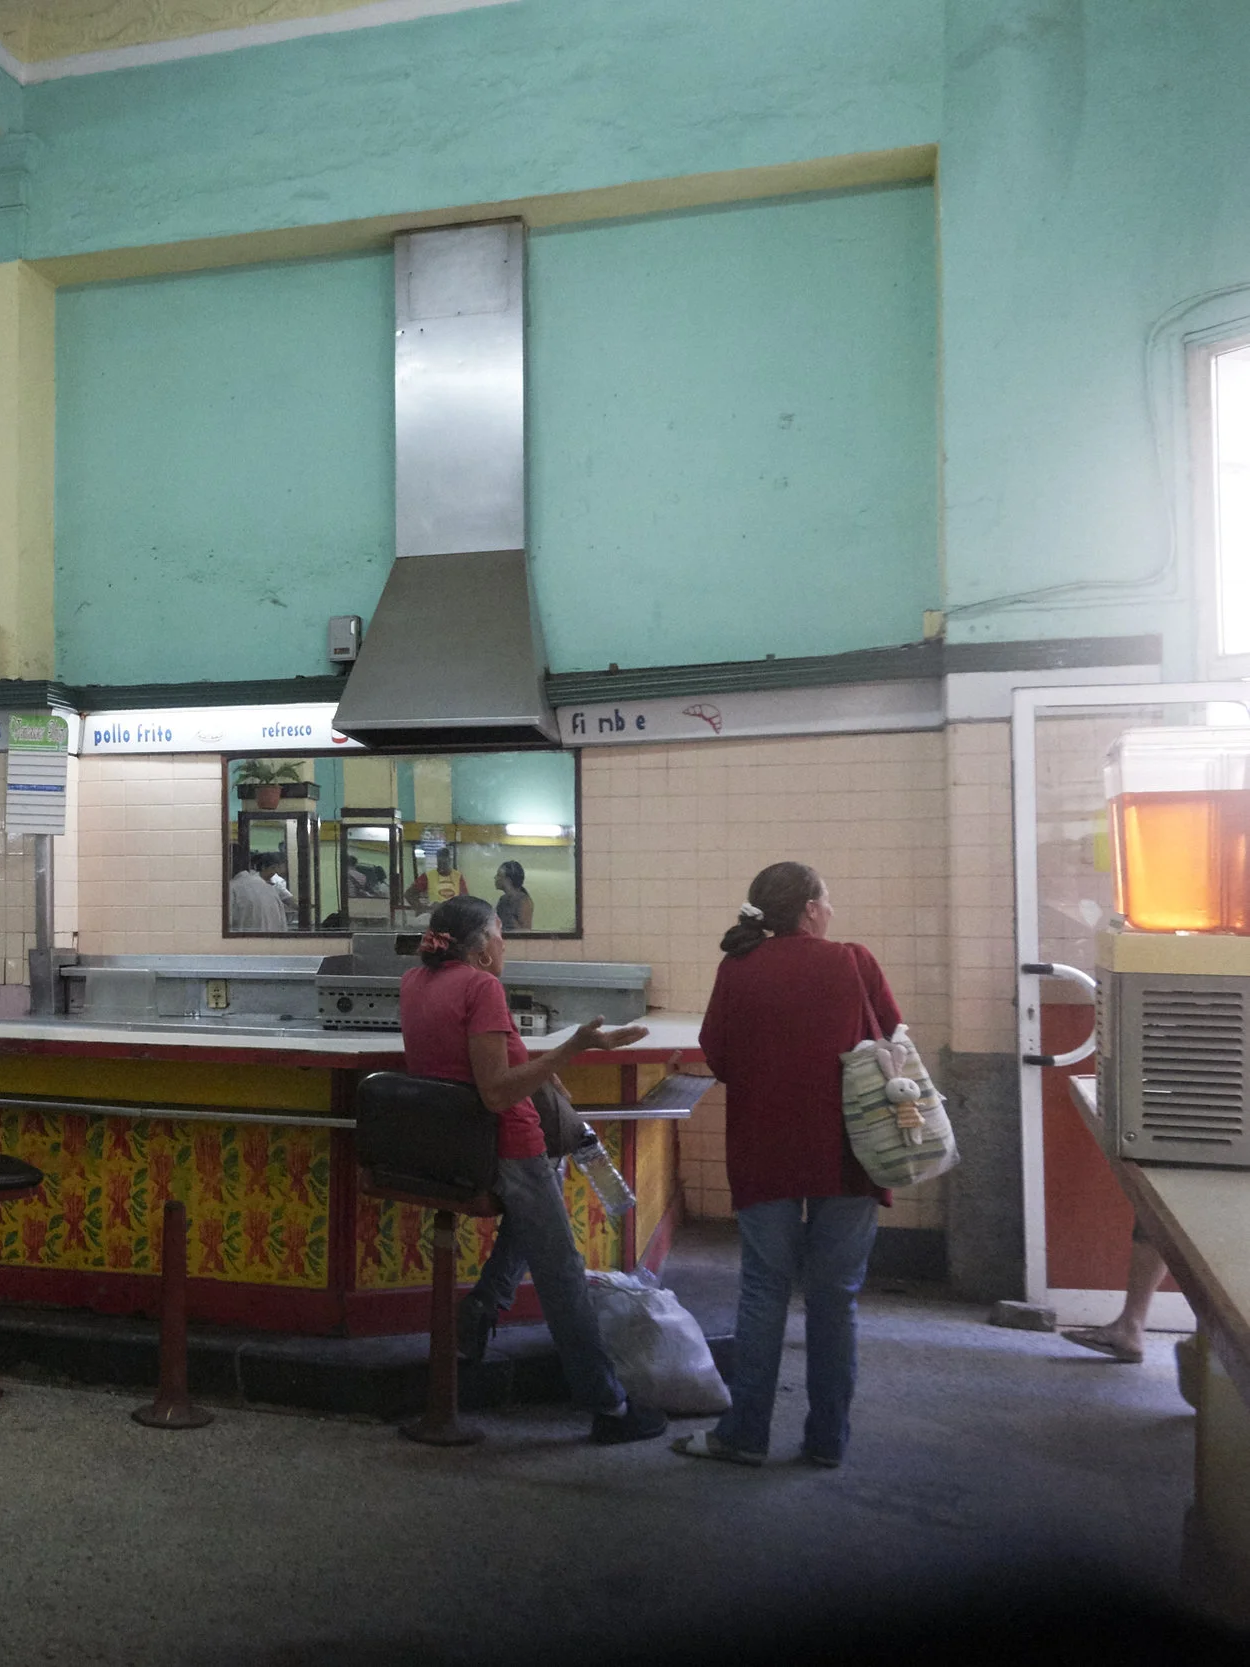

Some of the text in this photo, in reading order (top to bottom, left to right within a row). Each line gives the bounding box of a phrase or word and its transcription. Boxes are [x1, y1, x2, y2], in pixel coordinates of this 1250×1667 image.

[94, 723, 172, 746] pollo frito
[262, 722, 312, 738] refresco
